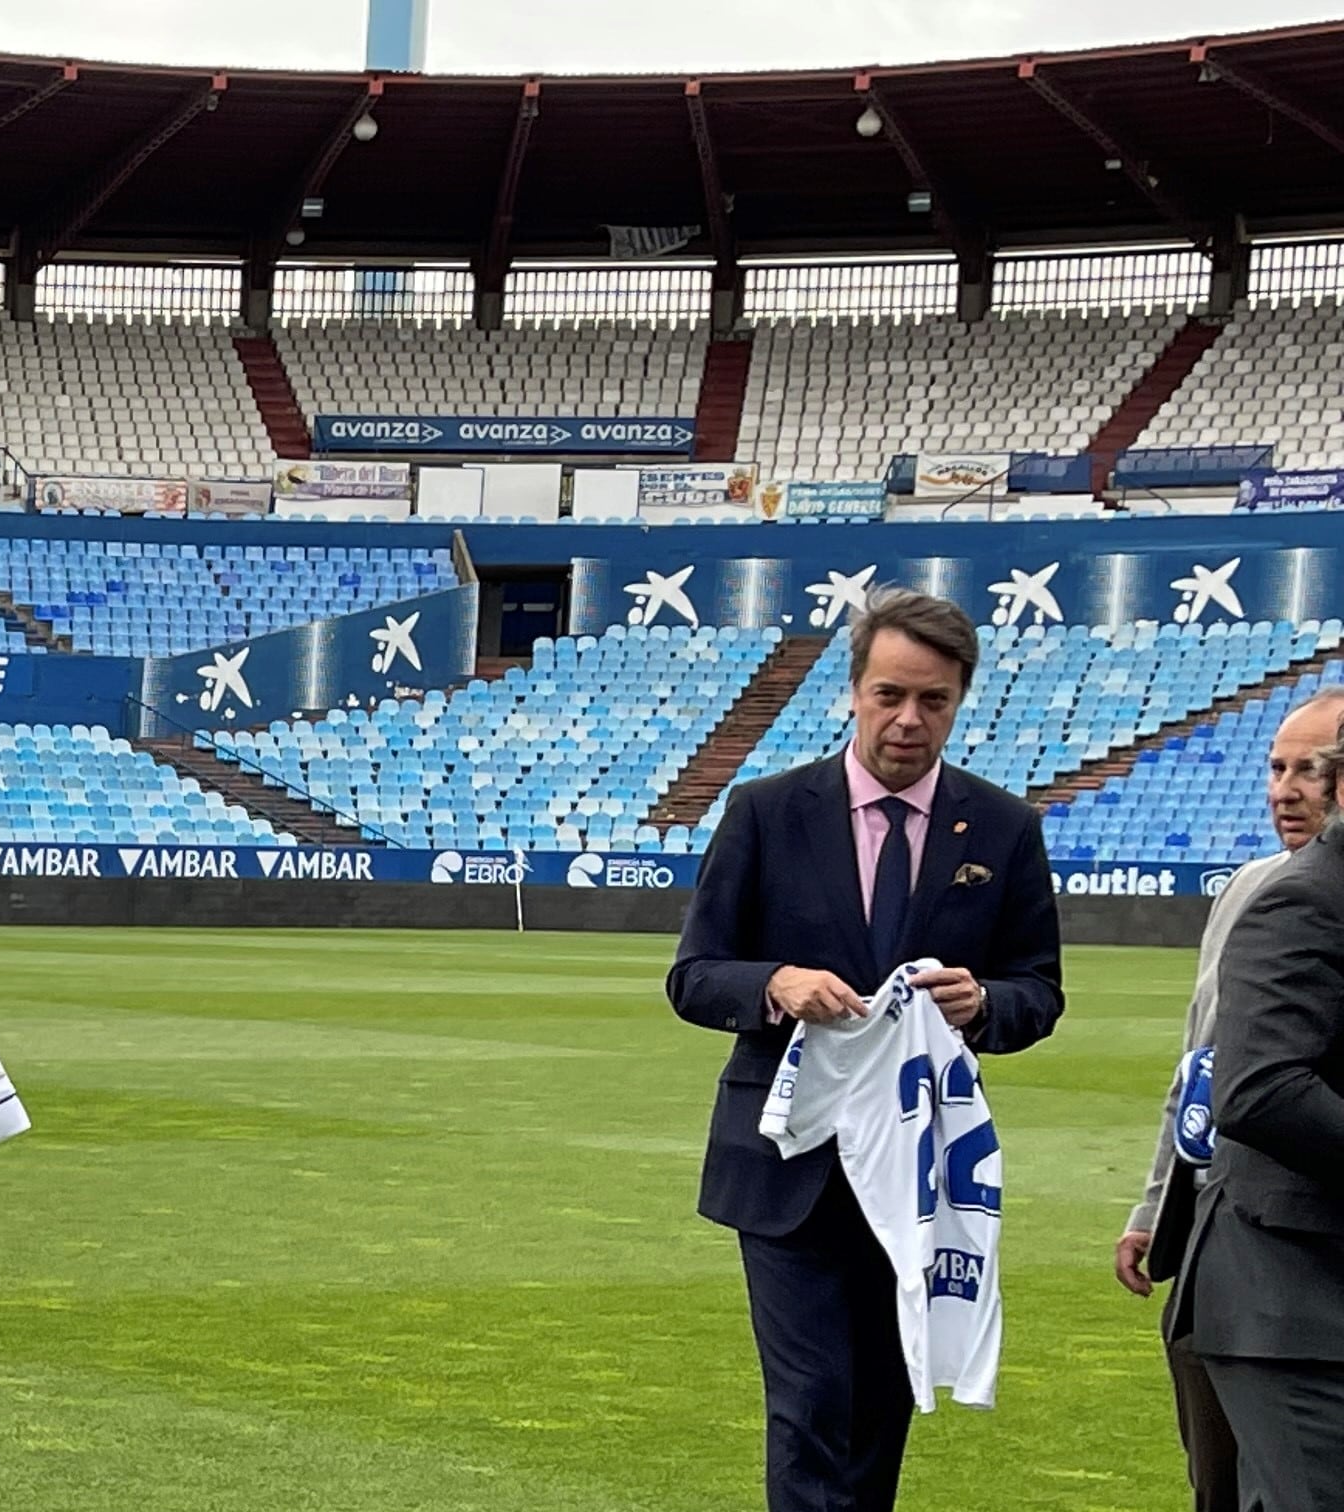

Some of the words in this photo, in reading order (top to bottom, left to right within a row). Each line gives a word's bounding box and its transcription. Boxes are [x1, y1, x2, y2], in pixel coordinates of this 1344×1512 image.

[331, 421, 420, 438] avanza
[459, 422, 548, 440] avanza
[581, 422, 673, 441] avanza
[2, 847, 102, 877] AMBAR
[139, 850, 240, 879] AMBAR
[277, 851, 374, 881] AMBAR
[464, 863, 524, 885] EBRO
[606, 866, 674, 889] EBRO
[1066, 867, 1176, 896] outlet
